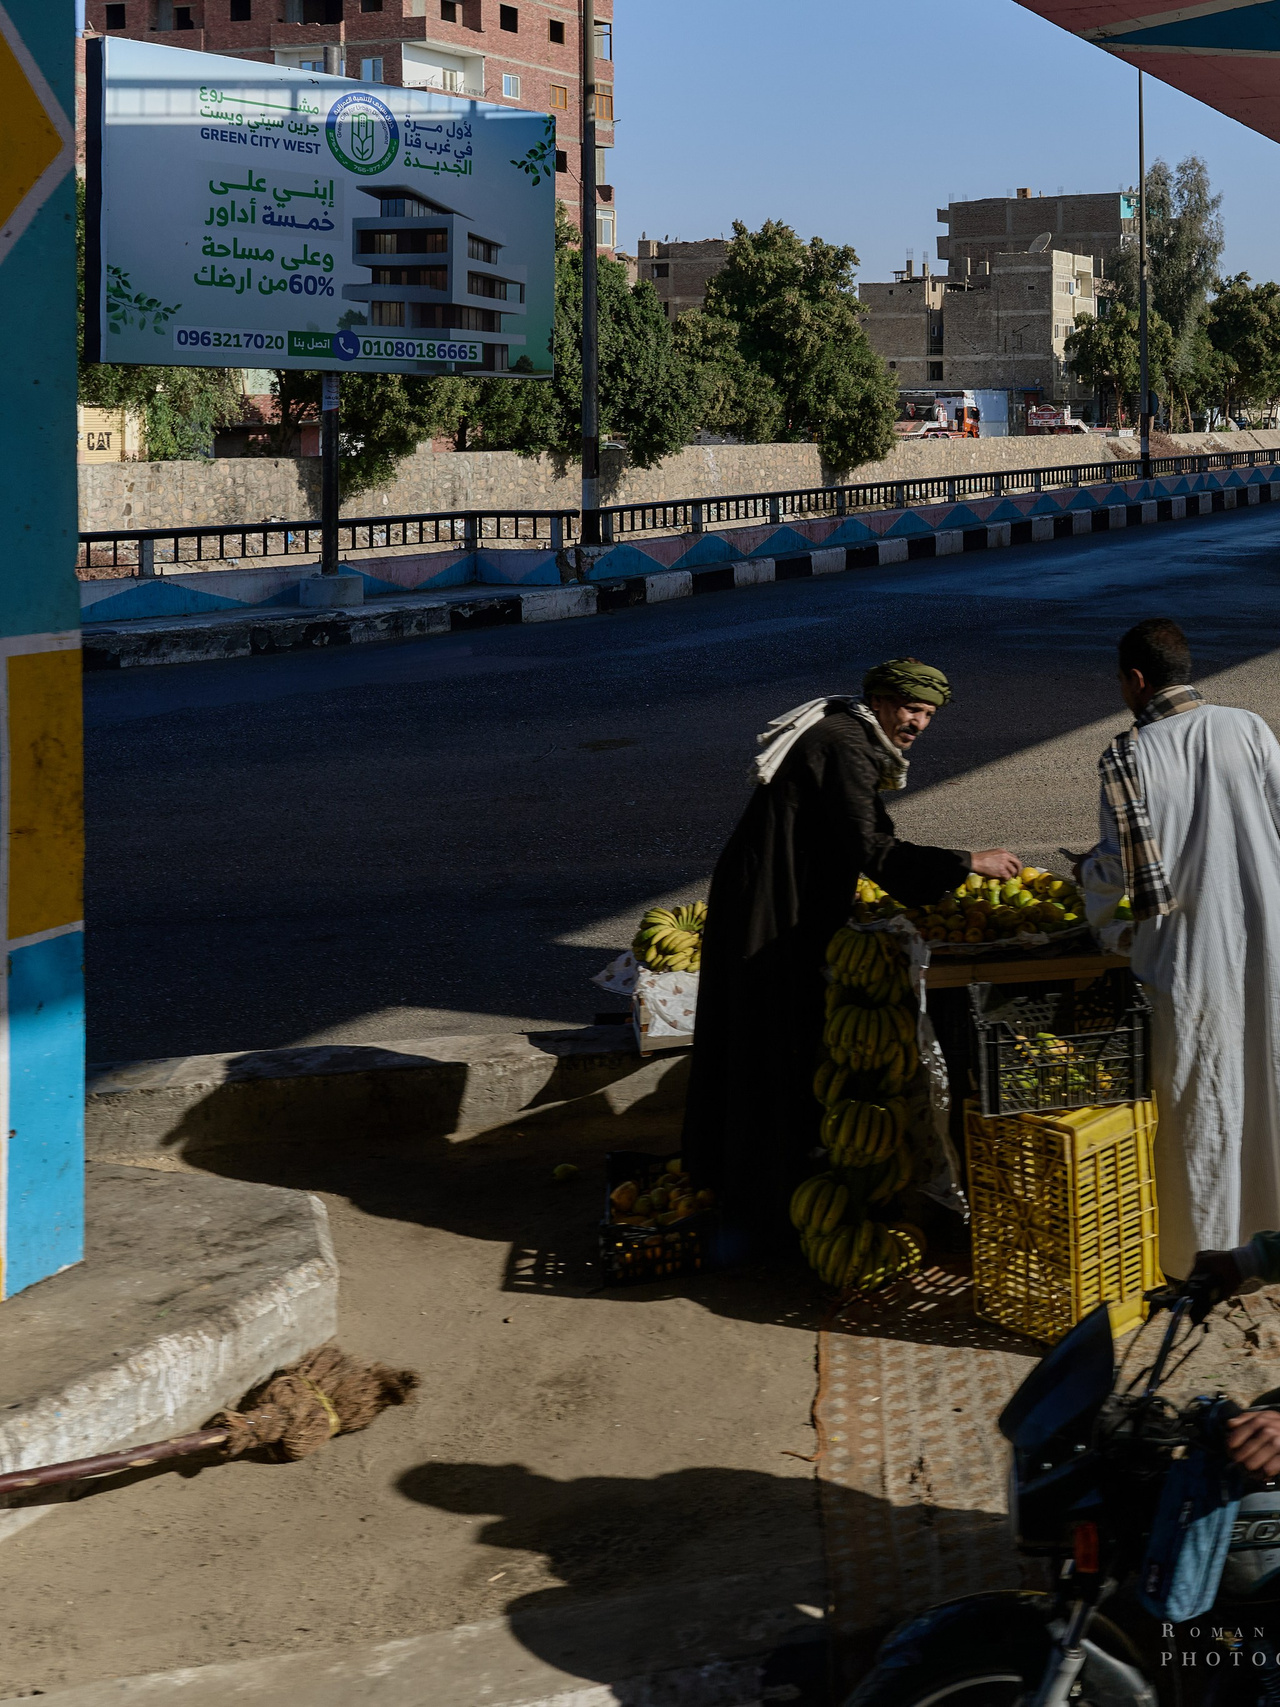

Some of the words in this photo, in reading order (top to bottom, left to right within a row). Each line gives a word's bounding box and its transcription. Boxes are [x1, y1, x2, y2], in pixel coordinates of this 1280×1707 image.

[199, 86, 319, 115] مشروع
[199, 105, 244, 126] ويست
[247, 113, 284, 133] سيتي
[404, 114, 443, 133] مرة
[287, 120, 320, 137] جرين
[446, 121, 473, 140] لأول
[200, 127, 248, 145] GREEN
[250, 134, 280, 149] CITY
[282, 138, 321, 155] WEST
[404, 133, 422, 149] قنا
[424, 139, 451, 155] غرب
[454, 141, 473, 163] في
[403, 151, 472, 178] الجديدة
[208, 169, 267, 195] على
[272, 179, 335, 209] إبني
[204, 197, 257, 227] أداور
[262, 204, 335, 232] خمسة
[201, 235, 275, 263] مساحة
[280, 243, 335, 273] وعلى
[193, 264, 252, 296] ارضك
[176, 329, 285, 350] 0963217020
[292, 336, 306, 350] بنا
[307, 337, 331, 350] اتصل
[361, 339, 478, 361] 01080186665
[87, 432, 112, 450] CAT
